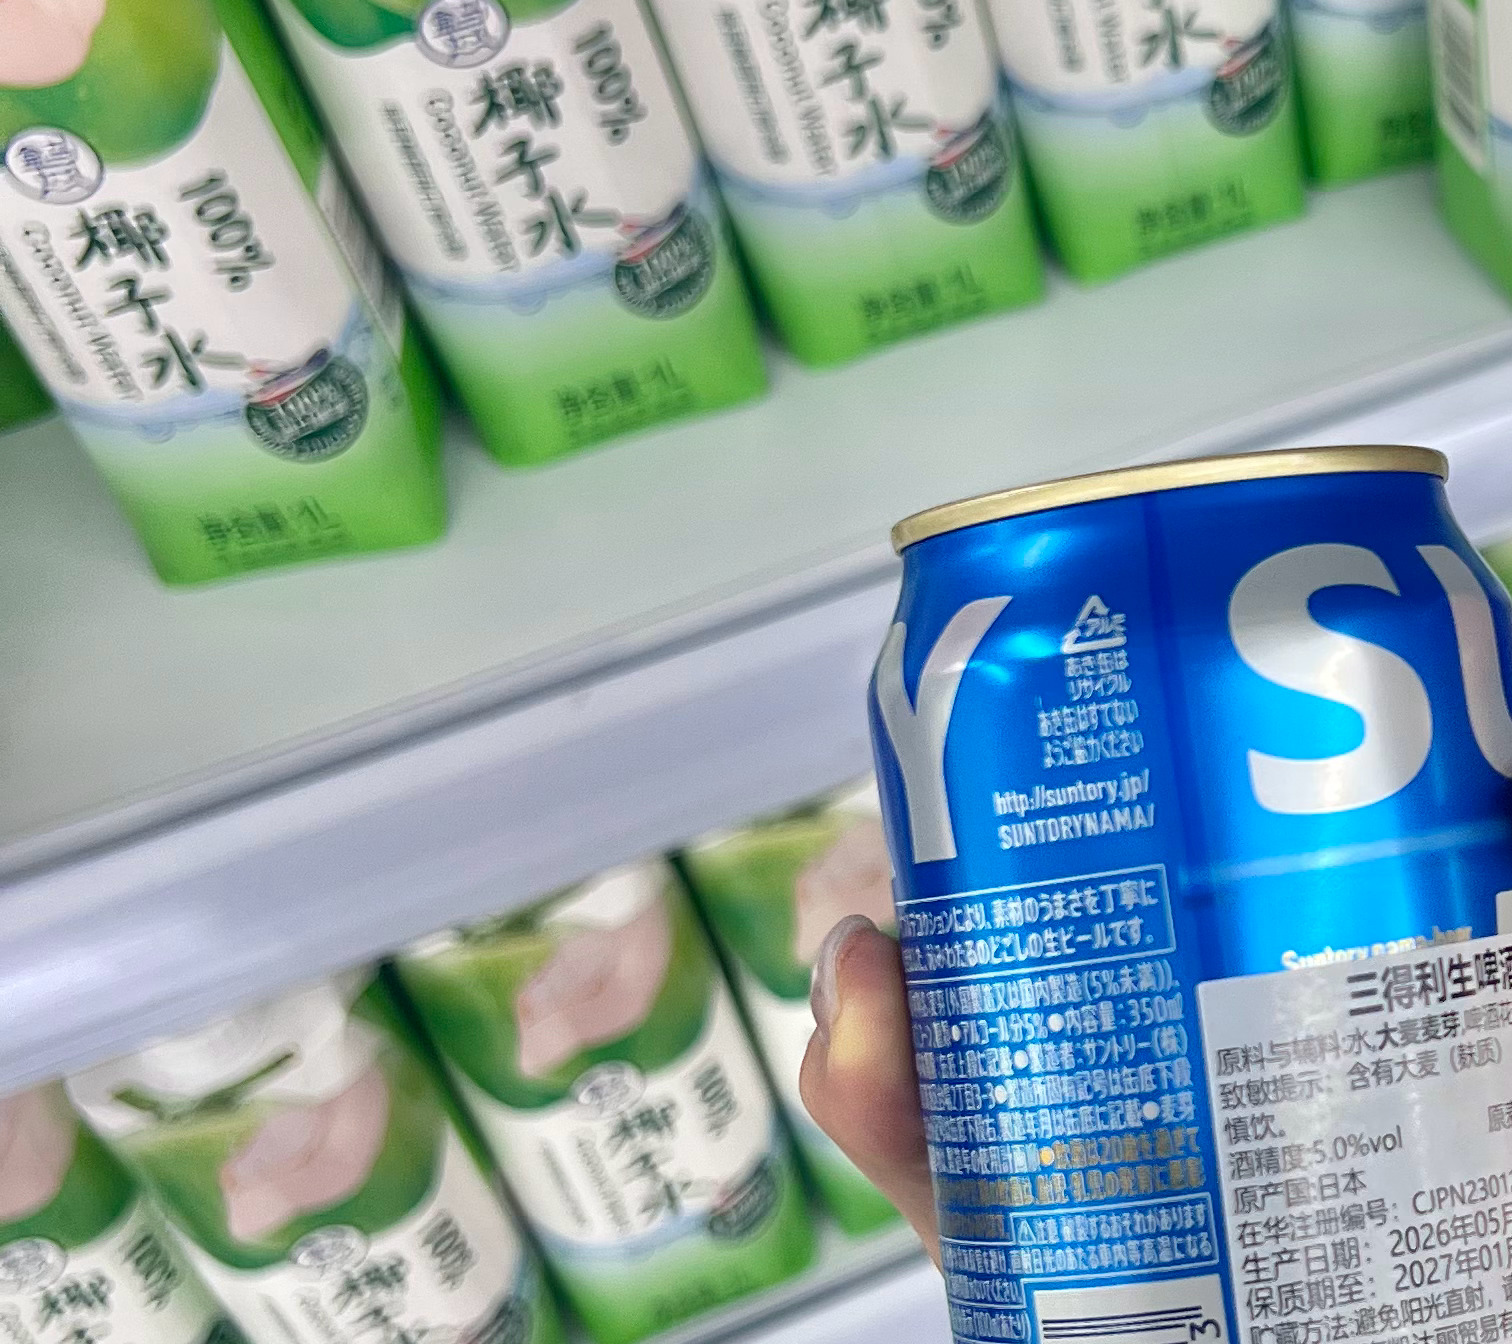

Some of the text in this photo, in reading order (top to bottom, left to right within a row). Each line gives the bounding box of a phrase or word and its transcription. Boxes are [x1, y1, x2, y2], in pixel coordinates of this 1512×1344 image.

[574, 23, 647, 145] 100%
[473, 65, 587, 256] 椰子水
[178, 168, 275, 291] 100%
[72, 201, 207, 394] 椰子水
[993, 768, 1149, 816] http://suntory.jp/
[998, 803, 1155, 850] SUNTORYNAMA/
[1233, 1167, 1367, 1214] 原产国:日本
